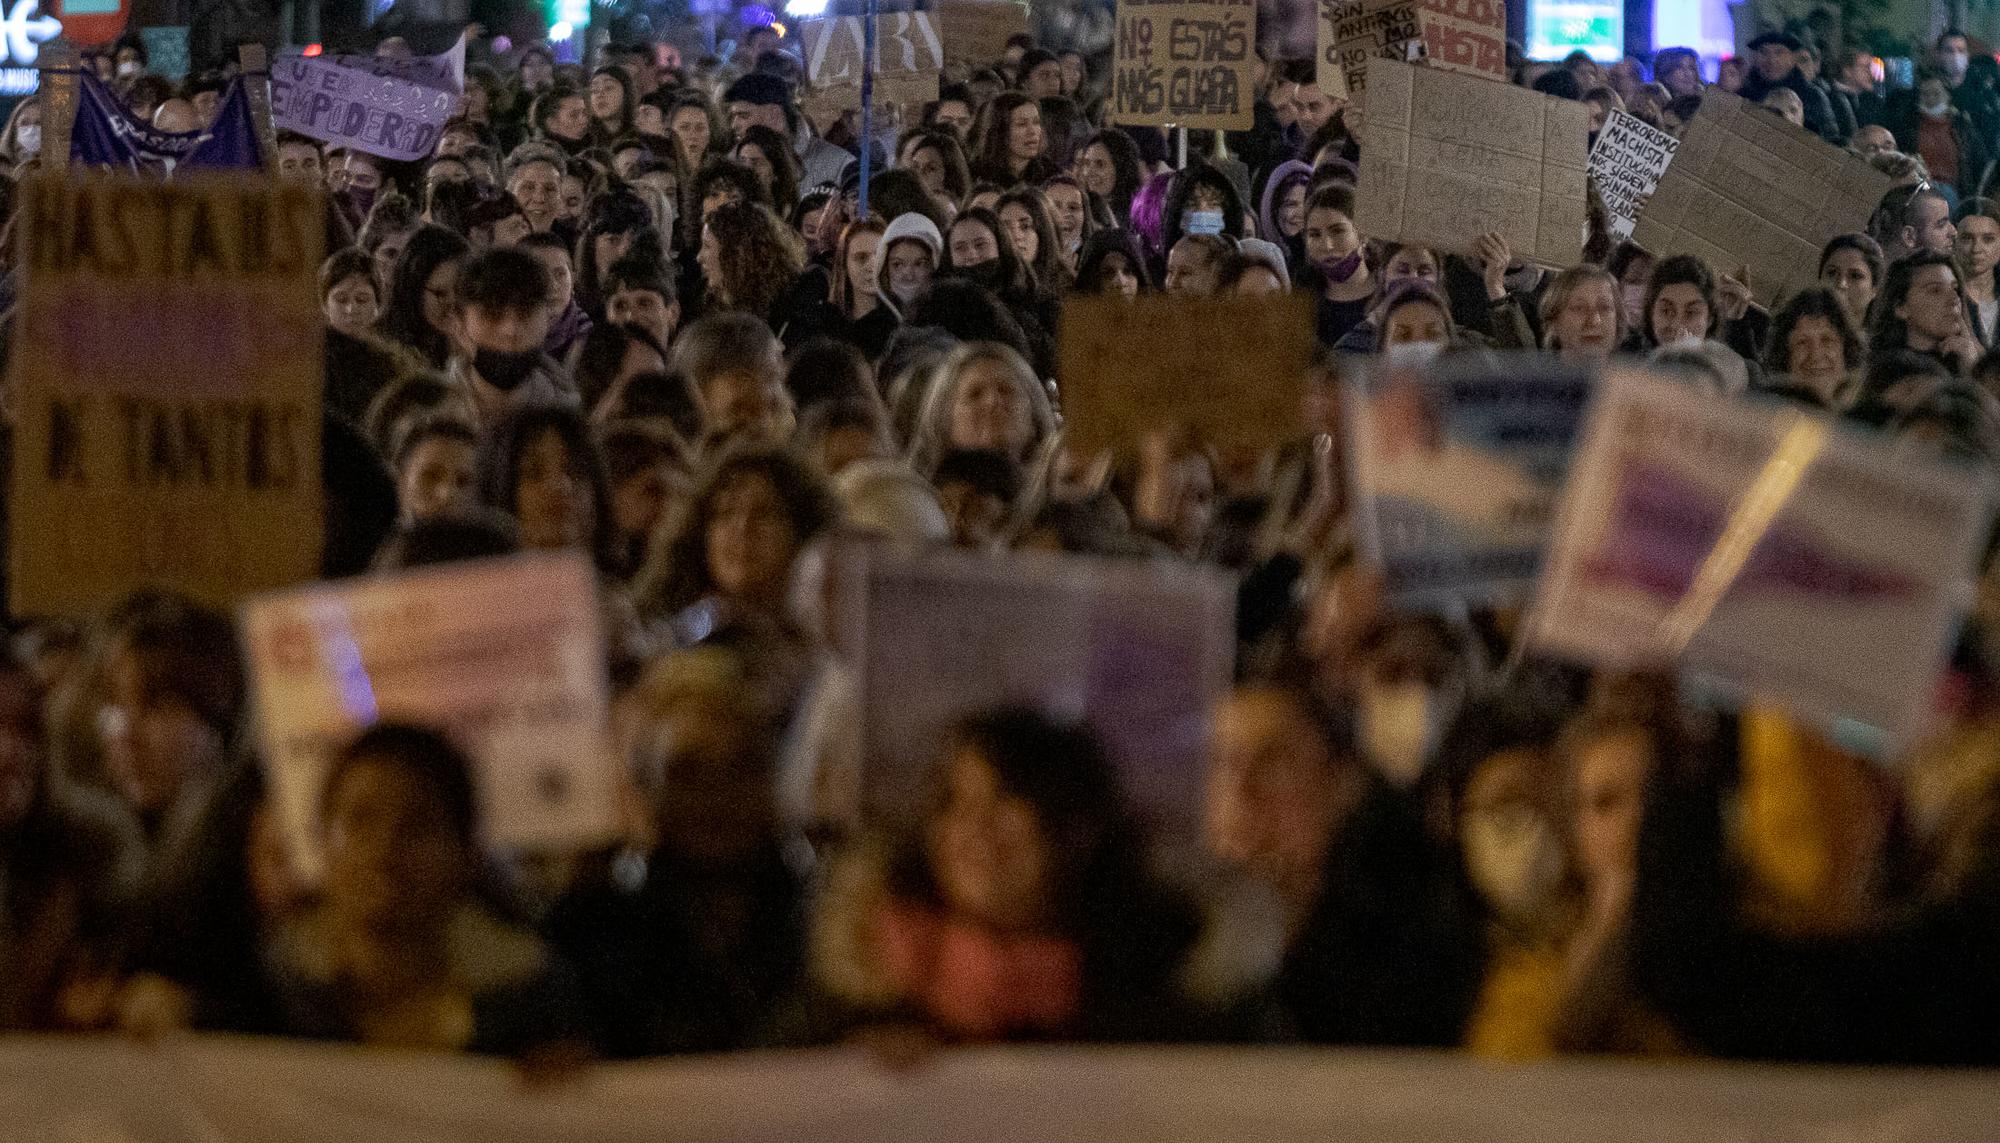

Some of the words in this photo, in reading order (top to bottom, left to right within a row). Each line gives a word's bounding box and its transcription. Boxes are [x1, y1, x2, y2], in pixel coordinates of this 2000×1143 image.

[1606, 126, 1665, 169] MACHISTA
[1612, 108, 1679, 154] TERRORISMO
[1589, 152, 1607, 170] NOS
[1609, 164, 1648, 192] SIGUEN
[31, 184, 228, 278] HASTA
